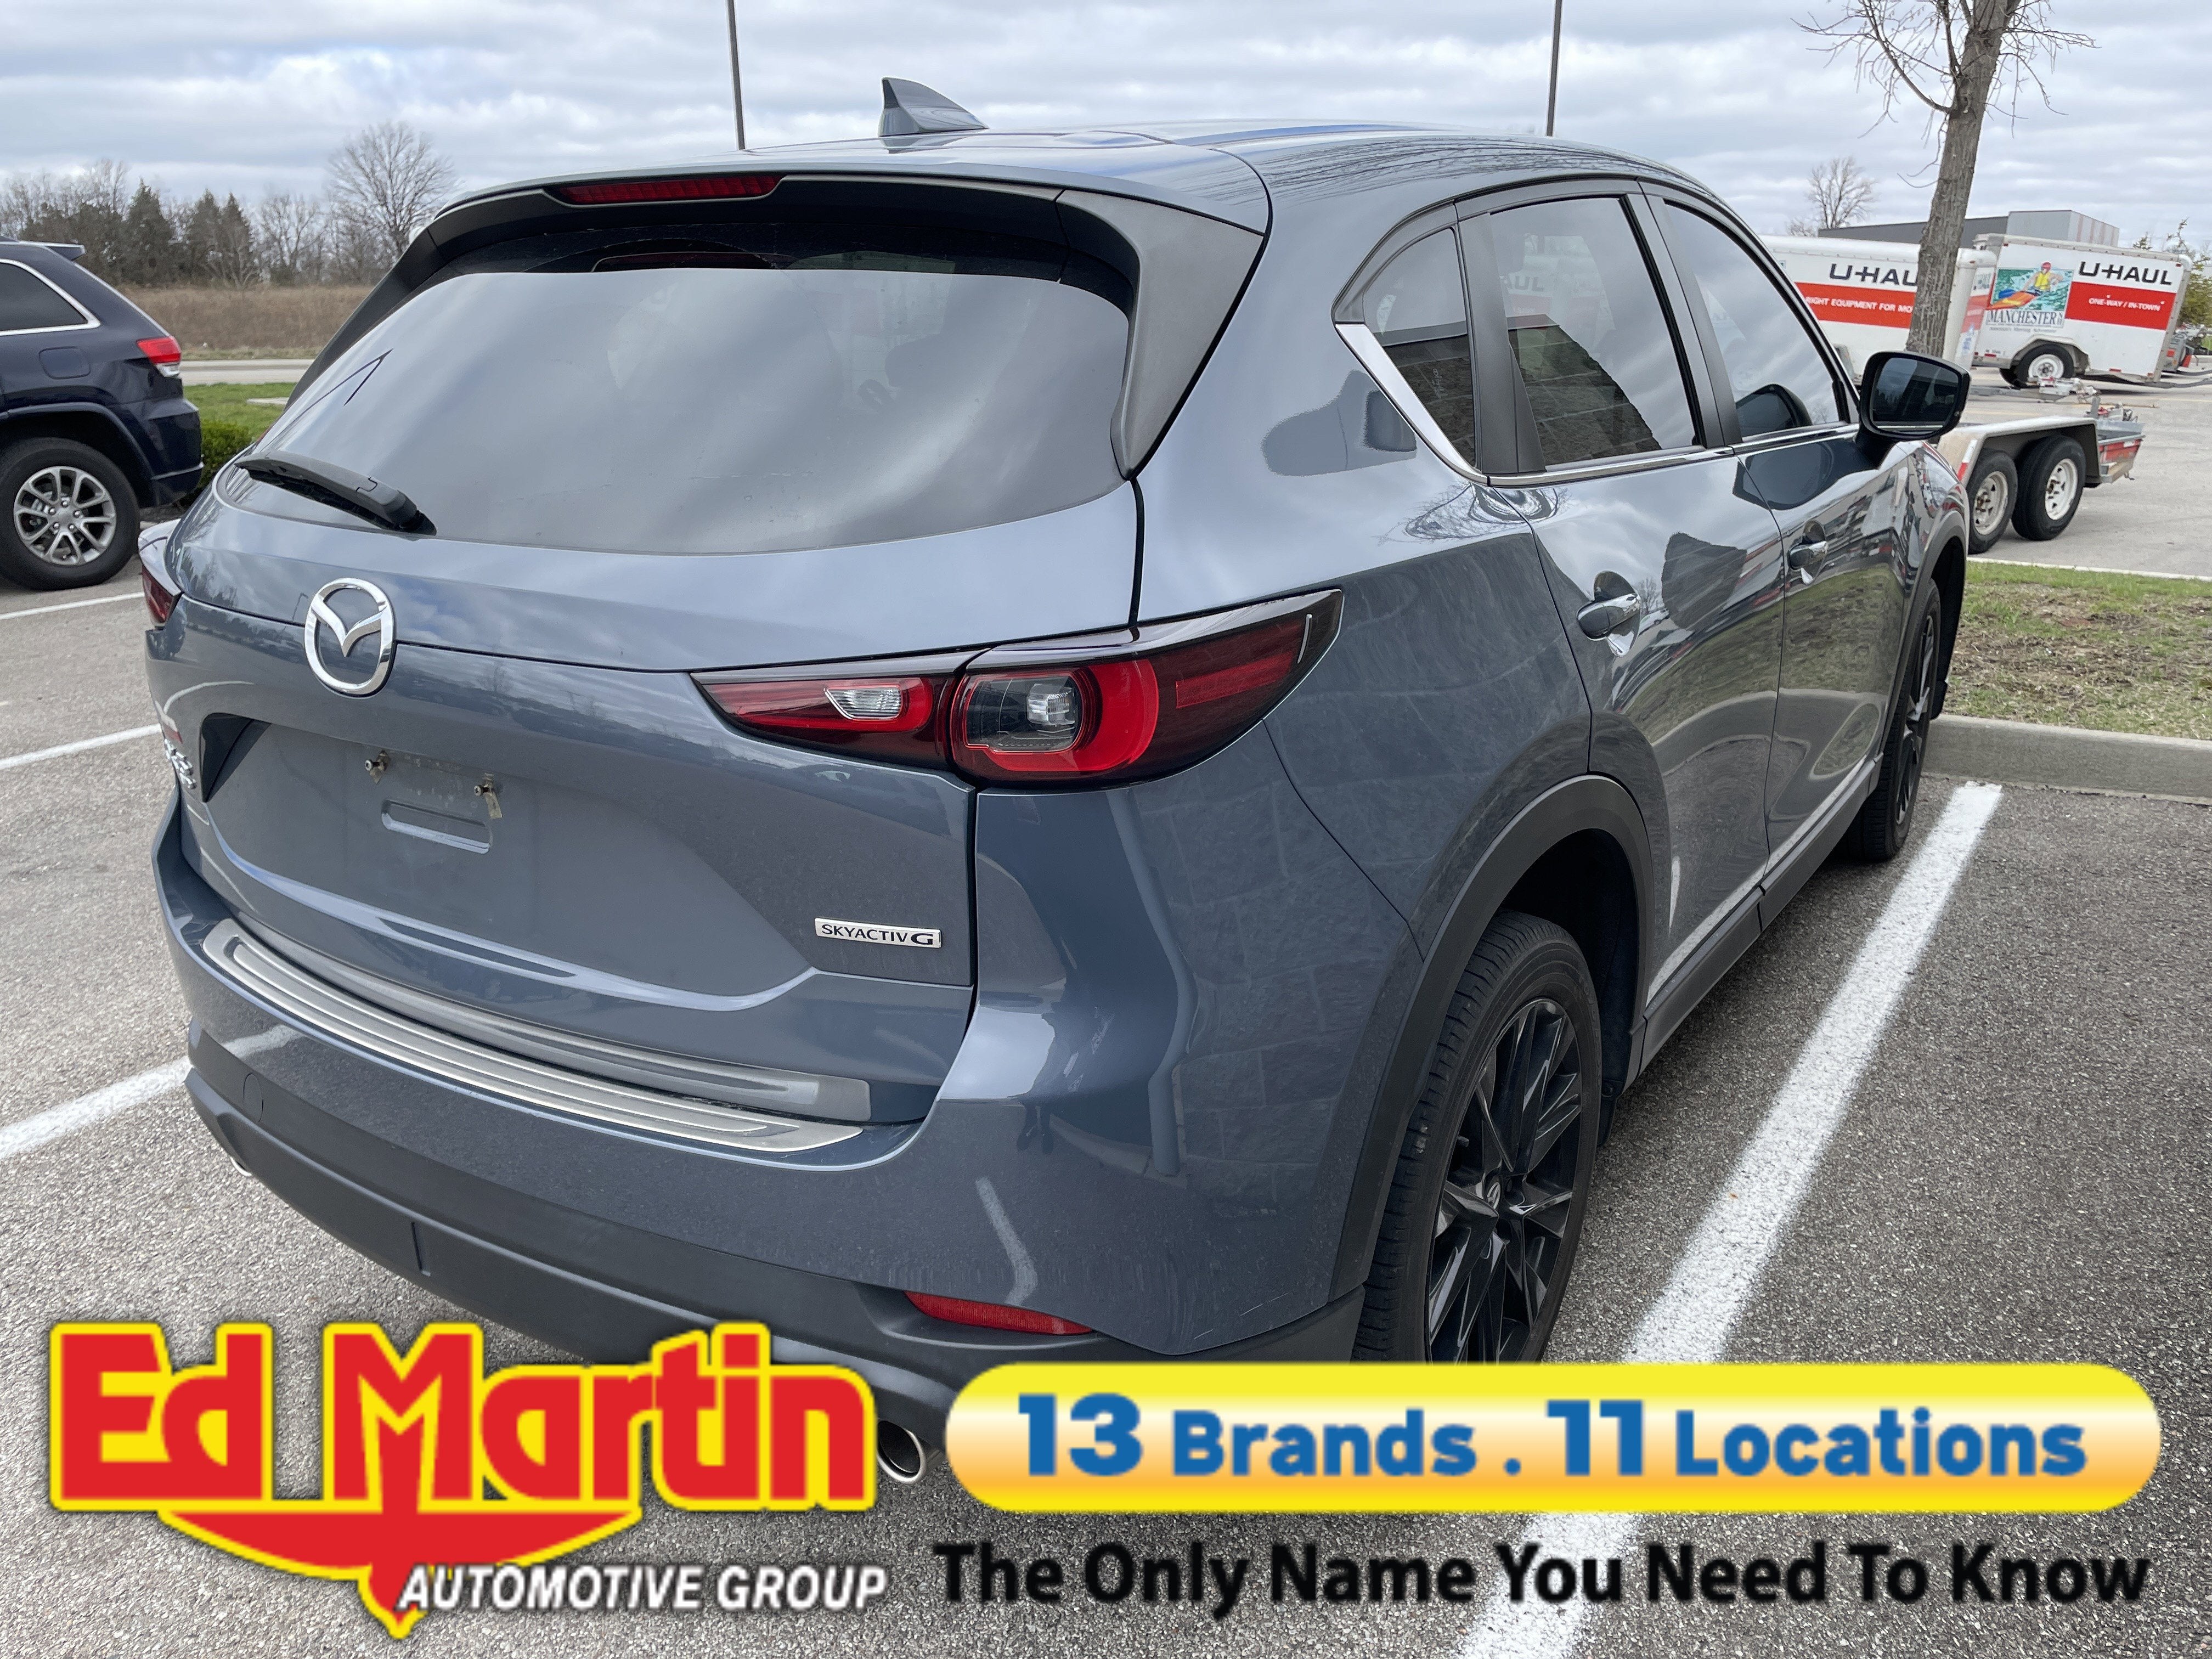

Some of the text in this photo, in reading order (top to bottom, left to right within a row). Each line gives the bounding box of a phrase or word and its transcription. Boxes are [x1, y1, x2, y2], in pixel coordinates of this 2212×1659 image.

[1829, 263, 1918, 286] U-HAU
[2079, 261, 2172, 285] U-HAUL
[1831, 298, 1877, 311] EQUIPMENT
[1878, 302, 1896, 312] FOR
[2088, 297, 2123, 307] ONE-WAY
[2128, 302, 2161, 312] IN-TOWN
[1987, 309, 2056, 325] MANCHESTER
